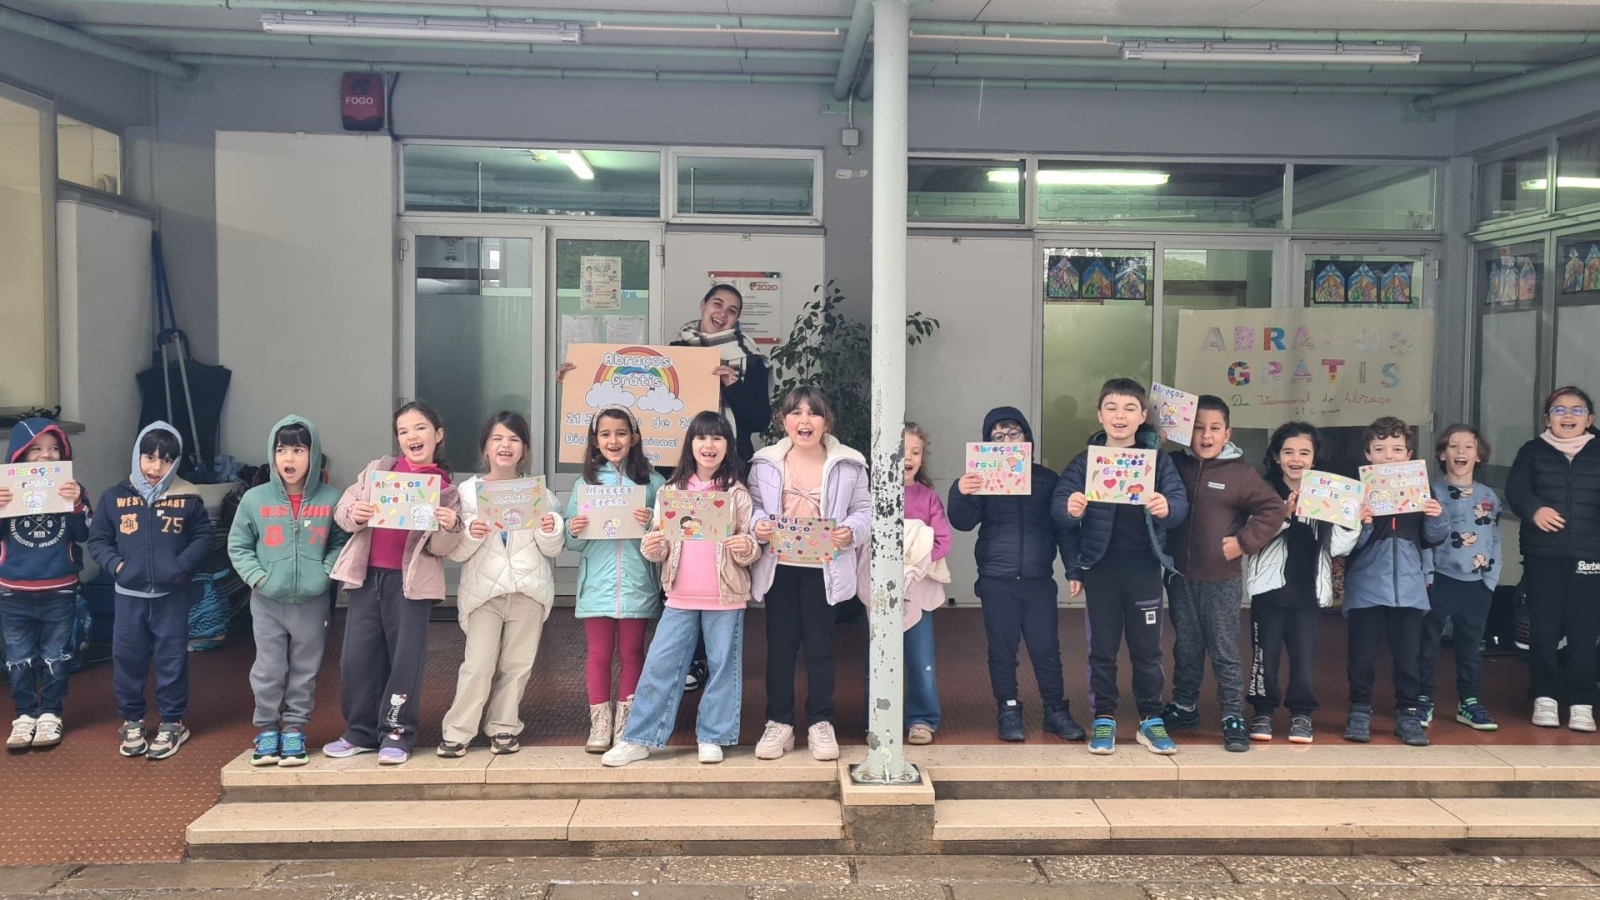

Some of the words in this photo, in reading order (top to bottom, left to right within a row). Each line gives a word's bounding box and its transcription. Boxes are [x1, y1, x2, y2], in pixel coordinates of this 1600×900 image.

[345, 96, 374, 105] FOGO
[603, 353, 671, 369] Abraços
[1227, 358, 1402, 389] GRÁTIS
[611, 373, 663, 387] Grátis
[1153, 384, 1185, 399] Abraços
[566, 413, 581, 424] 21
[651, 417, 670, 428] de
[564, 433, 588, 444] Dia
[973, 444, 1020, 456] Abraços
[1096, 456, 1144, 468] Abraços
[7, 466, 62, 477] Abraços
[1103, 467, 1140, 478] Grátis
[374, 480, 422, 491] Abraços
[117, 496, 144, 508] WEST
[161, 515, 184, 534] 75
[308, 526, 328, 545] 75
